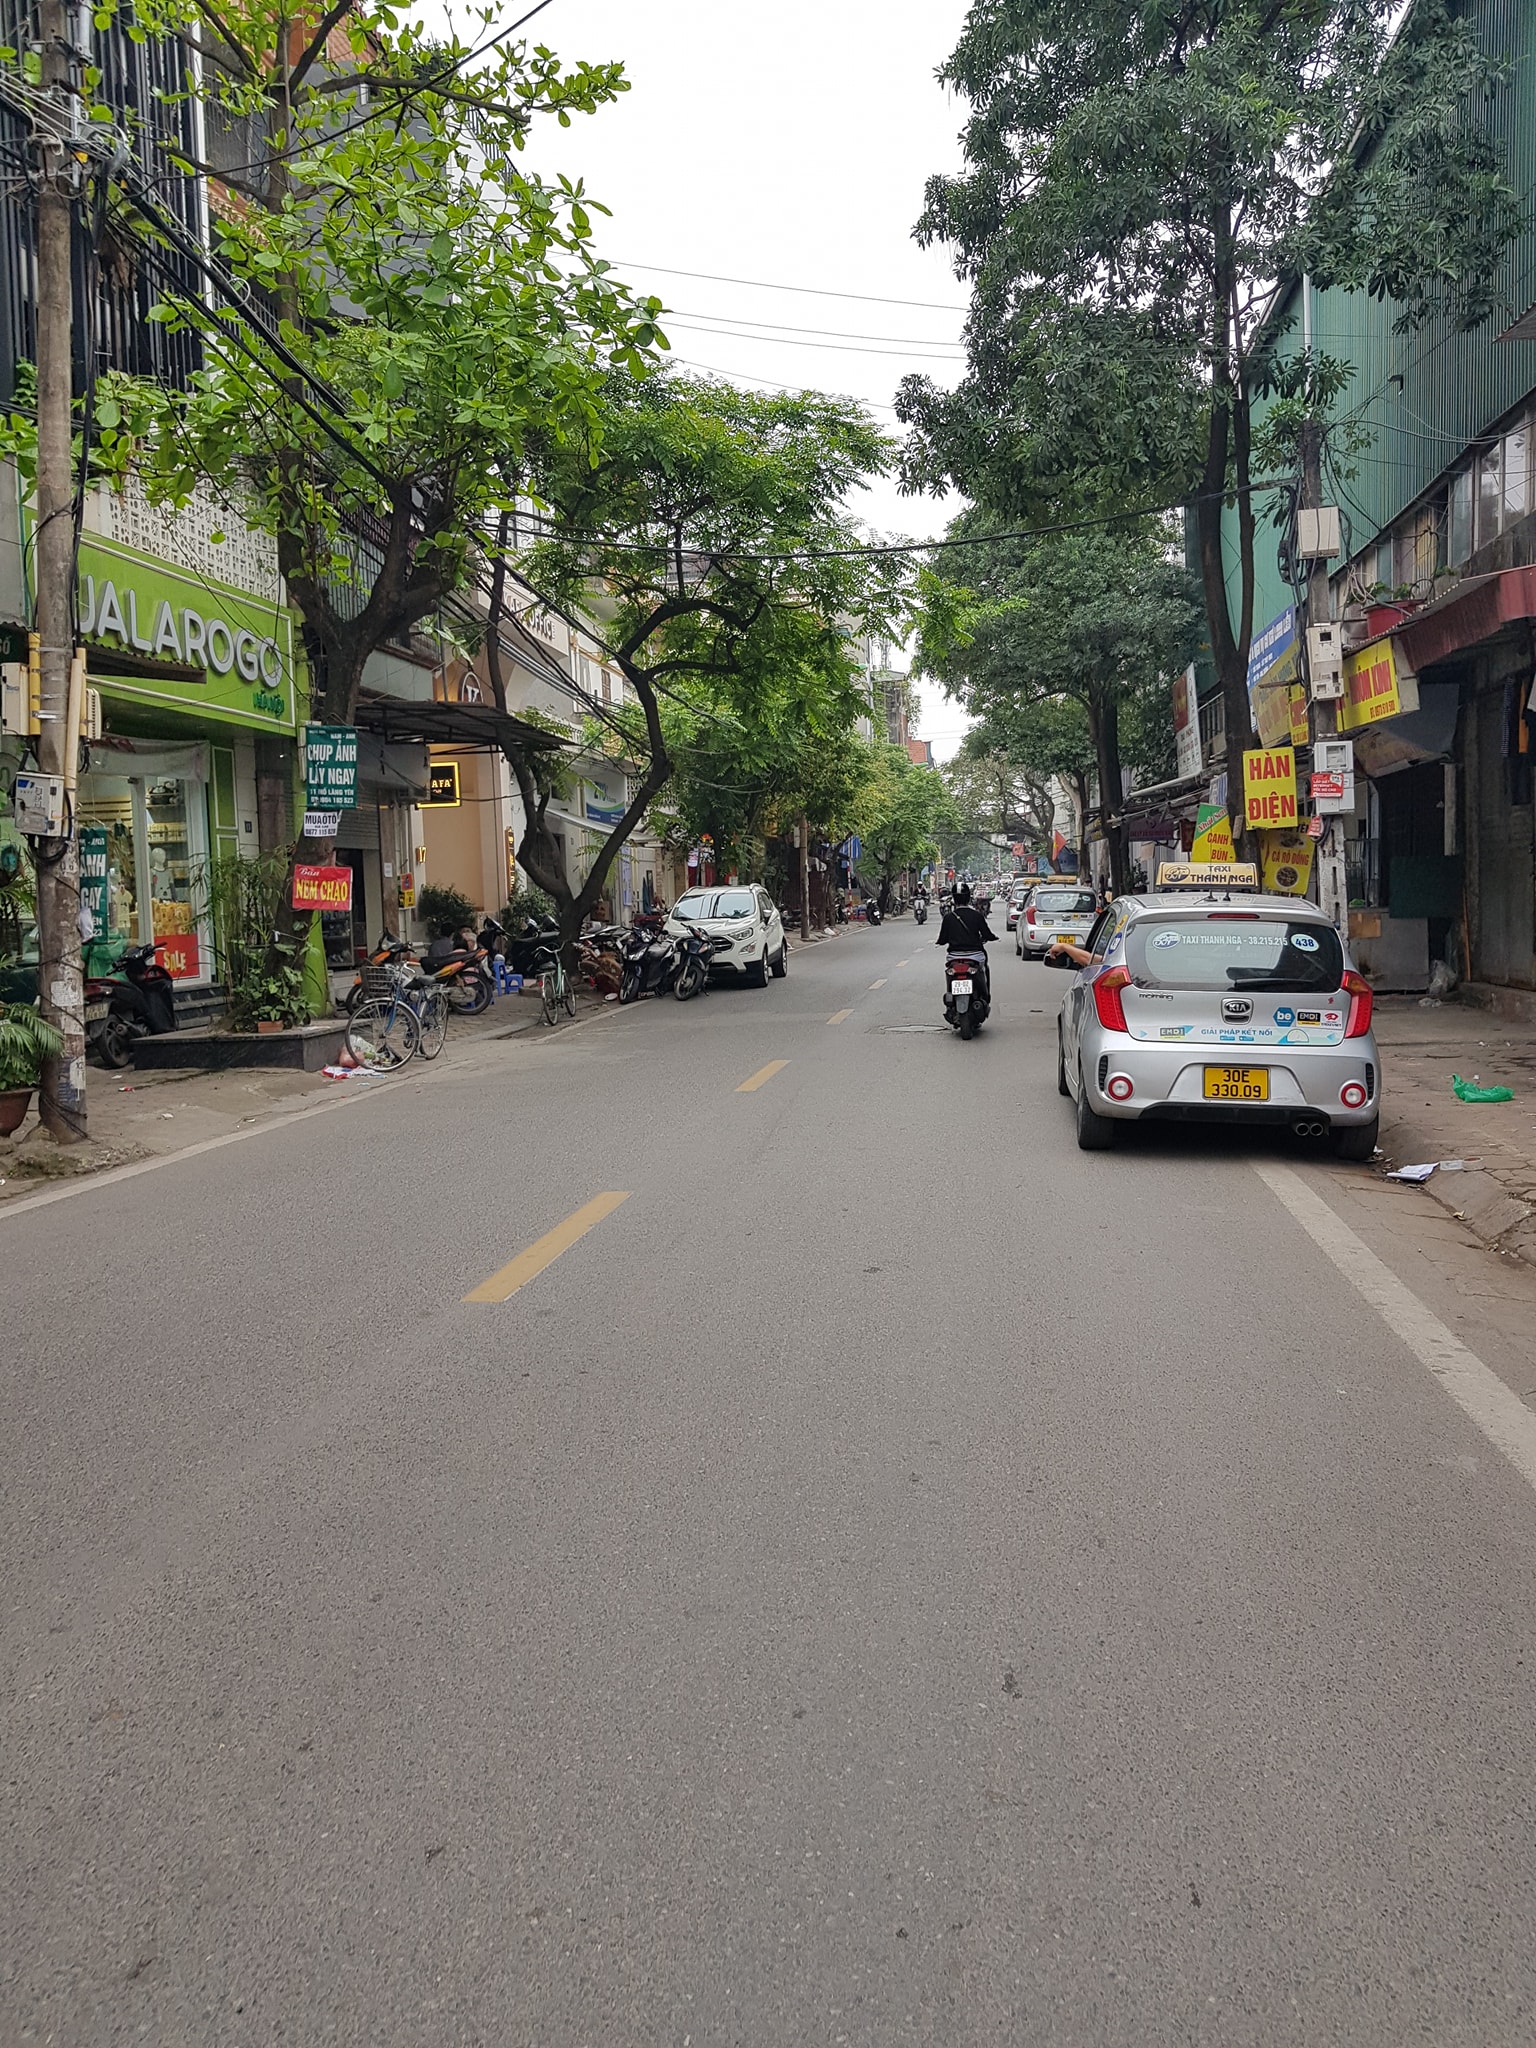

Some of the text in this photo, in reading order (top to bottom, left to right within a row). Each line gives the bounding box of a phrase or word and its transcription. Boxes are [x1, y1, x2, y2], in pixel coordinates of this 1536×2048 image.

[307, 740, 357, 765] CHỤP ẢNH
[1249, 751, 1291, 781] HÀN
[308, 761, 356, 786] LẤY NGAY
[1248, 790, 1296, 825] ĐIỆN
[1207, 865, 1231, 873] TAXI
[1190, 874, 1253, 883] THANH NGA
[1181, 935, 1199, 945] TAXI
[1200, 936, 1226, 945] THANH
[1226, 936, 1242, 945] NGA
[1248, 936, 1288, 946] 38.215.215
[1295, 937, 1314, 948] 438
[163, 950, 187, 971] SALE
[1139, 993, 1174, 1001] morning
[1227, 1003, 1247, 1012] KIA
[1276, 1011, 1292, 1020] be
[1160, 1028, 1185, 1036] EMDI
[1219, 1027, 1241, 1035] PHÁP
[1241, 1027, 1257, 1036] KẾT
[1258, 1027, 1273, 1036] NỐI
[1223, 1069, 1250, 1083] 30E
[1211, 1083, 1262, 1098] 330.09
